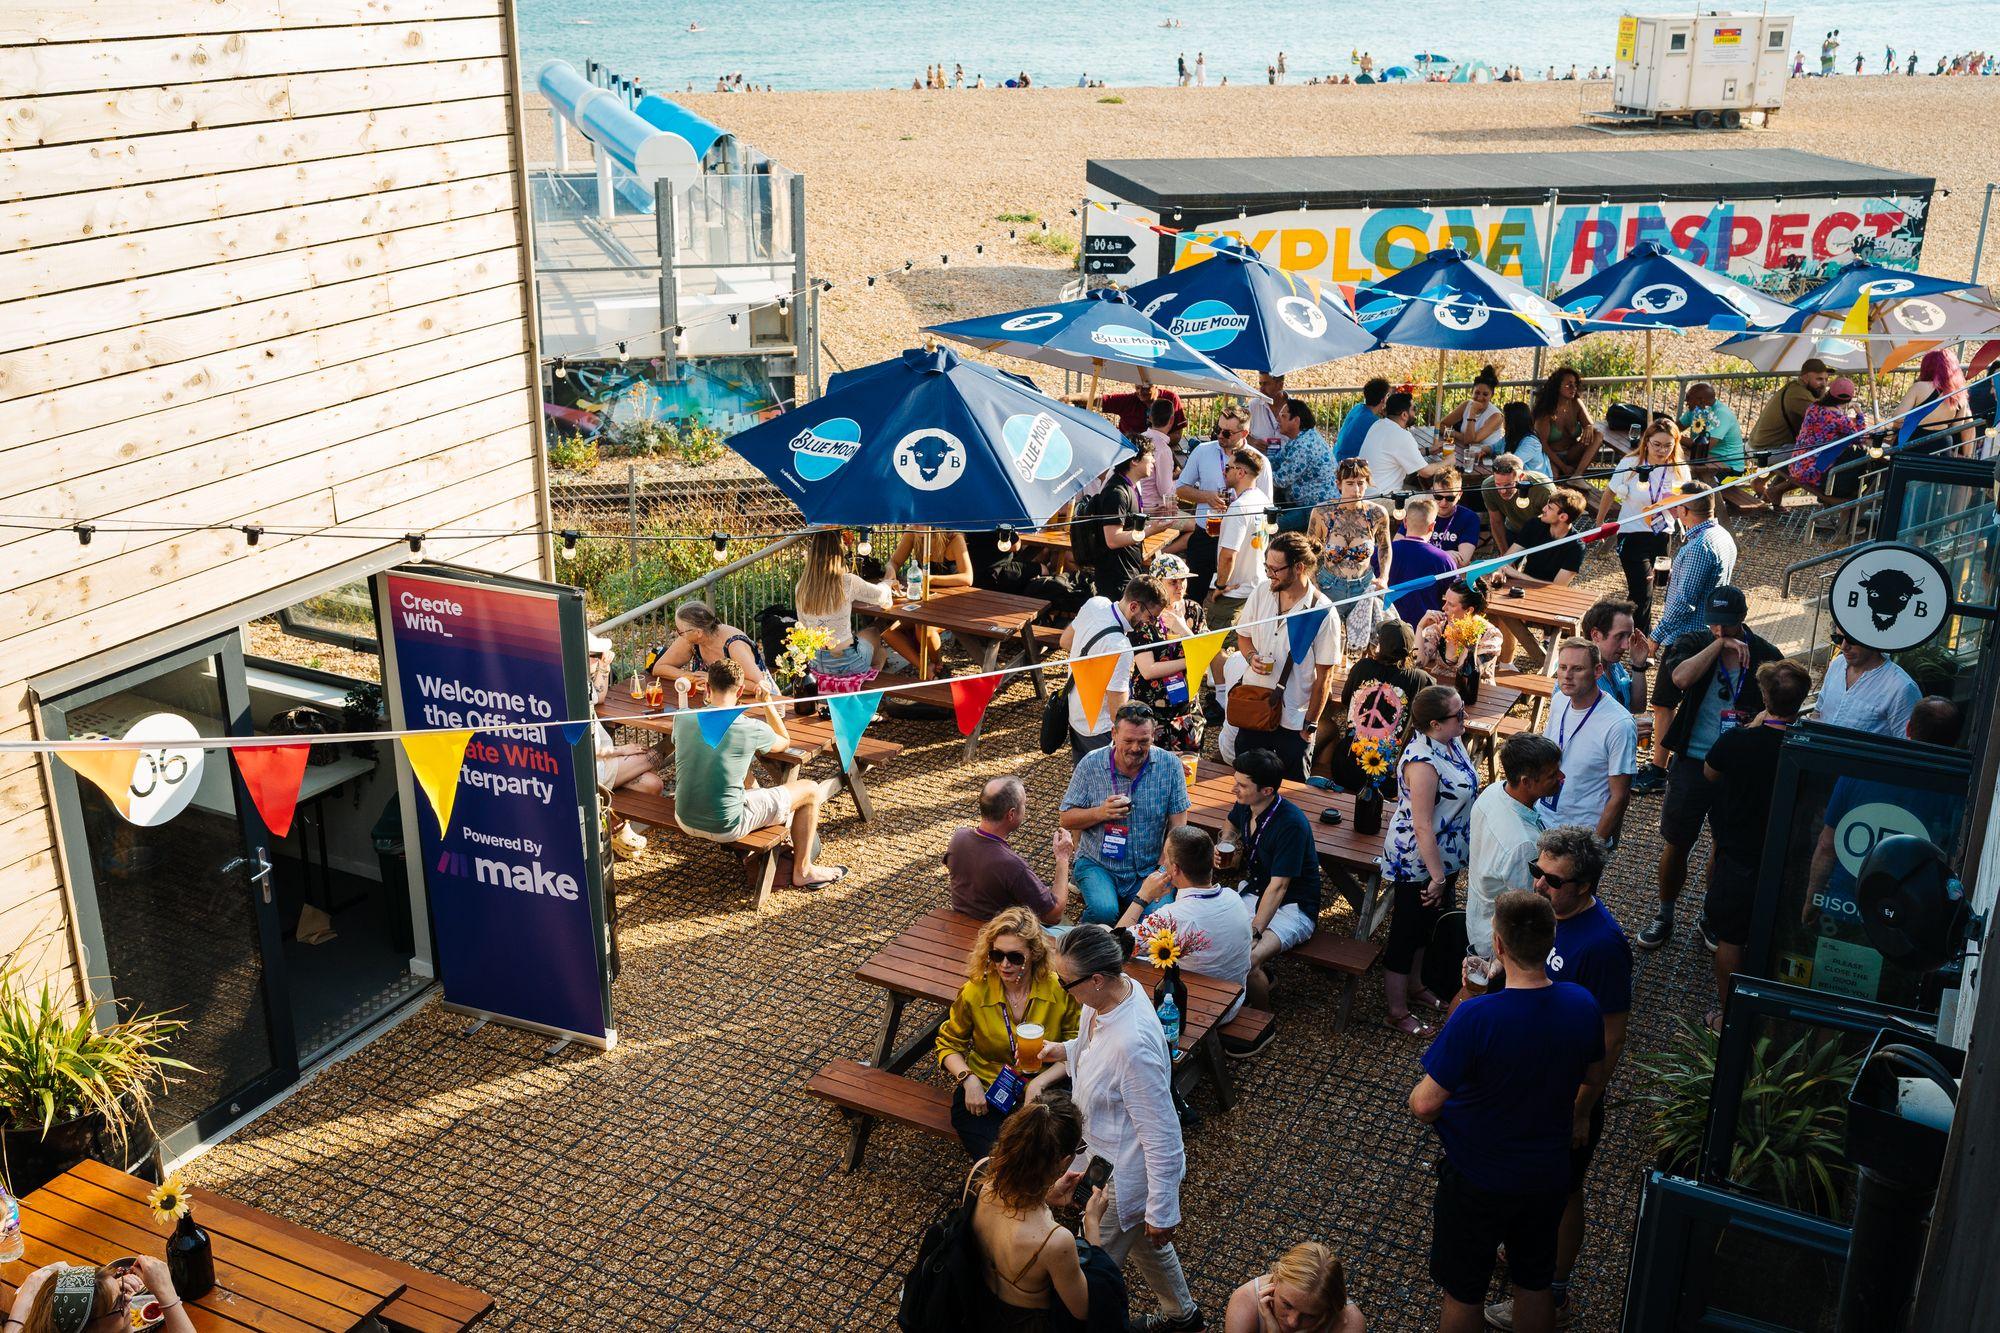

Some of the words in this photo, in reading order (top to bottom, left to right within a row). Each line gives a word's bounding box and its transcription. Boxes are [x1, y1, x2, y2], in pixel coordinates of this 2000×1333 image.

[1570, 211, 1904, 274] RESPECT
[1094, 333, 1128, 344] BLUE
[1131, 337, 1167, 347] MOON
[1170, 319, 1208, 336] BLUE
[1210, 316, 1247, 329] MOON
[790, 432, 830, 453] BLUE
[1016, 442, 1041, 480] BLUE
[1031, 416, 1056, 447] MOON
[900, 455, 908, 466] B
[951, 456, 960, 468] B
[1432, 531, 1458, 542] eate
[400, 591, 463, 616] Create
[1847, 591, 1859, 608] B
[1914, 600, 1928, 618] B
[416, 674, 525, 712] Welcome
[528, 694, 552, 719] to
[423, 704, 462, 728] the
[466, 710, 547, 745] Official
[465, 740, 500, 763] ate
[501, 743, 559, 775] With
[458, 763, 554, 805] terparty
[463, 826, 522, 851] Powered
[523, 838, 543, 857] By
[475, 857, 579, 900] make
[1812, 893, 1860, 915] BISO
